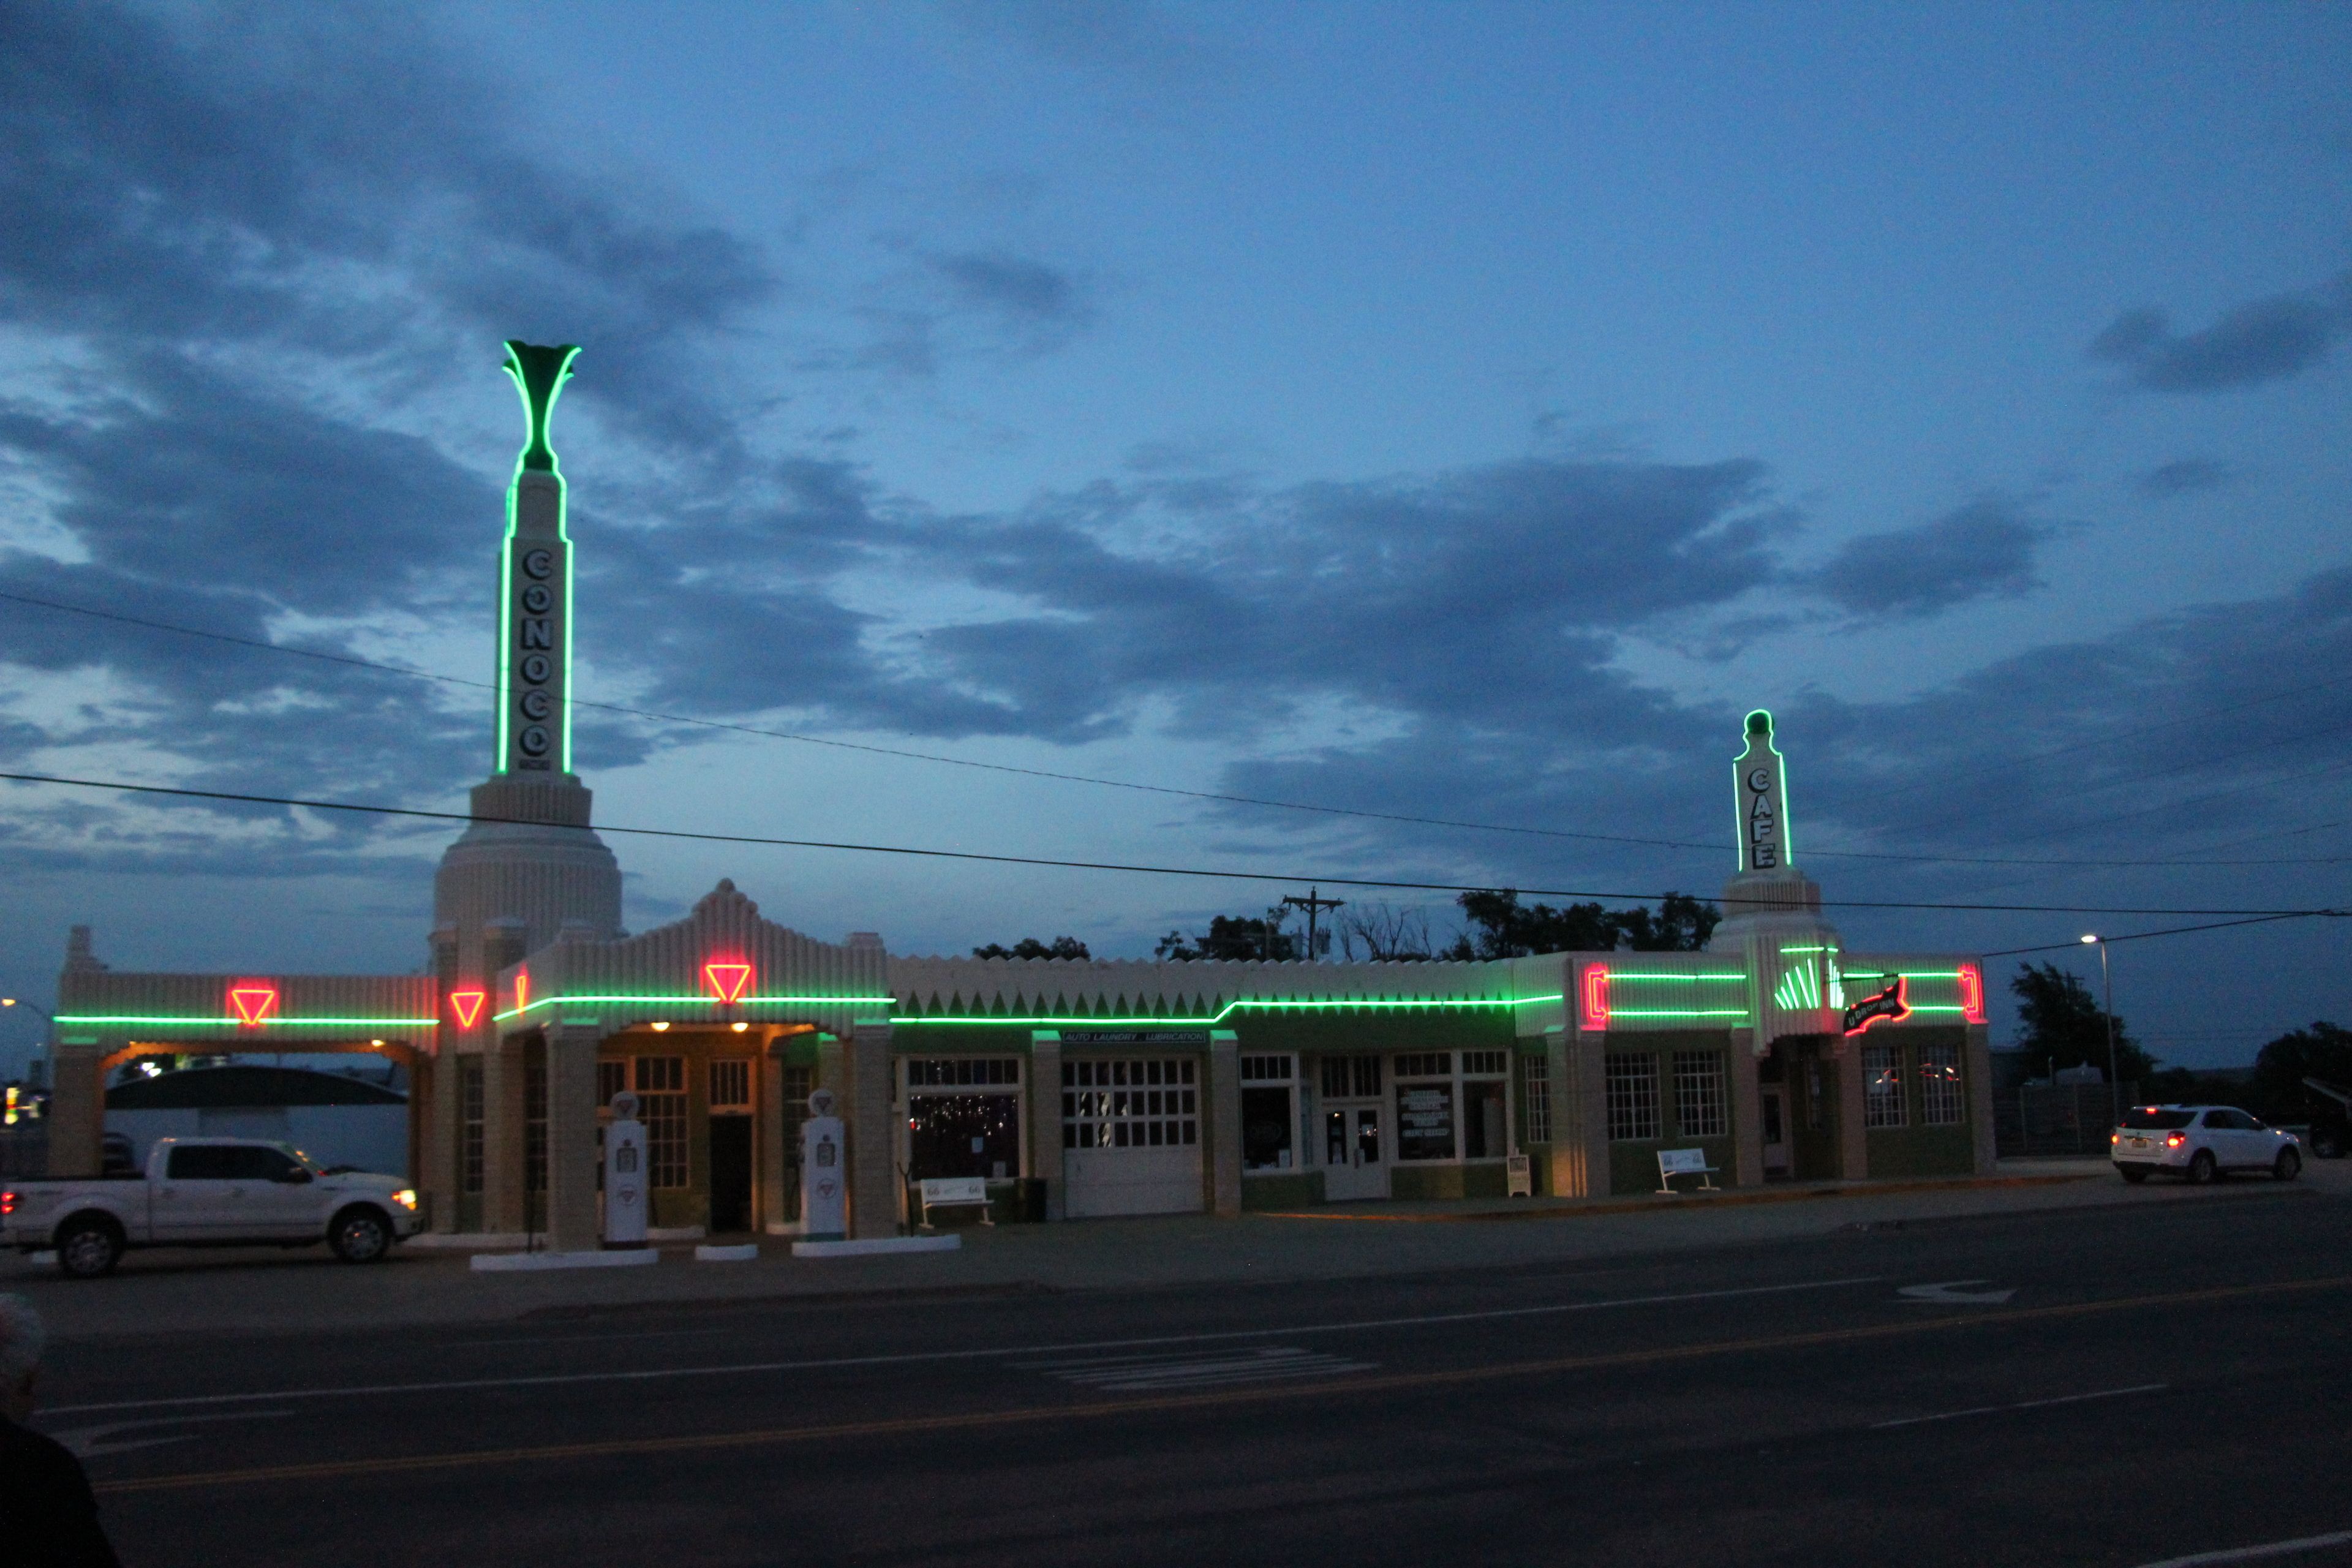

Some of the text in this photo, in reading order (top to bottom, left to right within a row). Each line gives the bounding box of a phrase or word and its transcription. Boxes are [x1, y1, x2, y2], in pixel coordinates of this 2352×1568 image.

[519, 549, 553, 757] CONOCO
[1747, 768, 1776, 870] CAFE
[1065, 1032, 1203, 1041] AUTO LAUNDRY LUBRICATION
